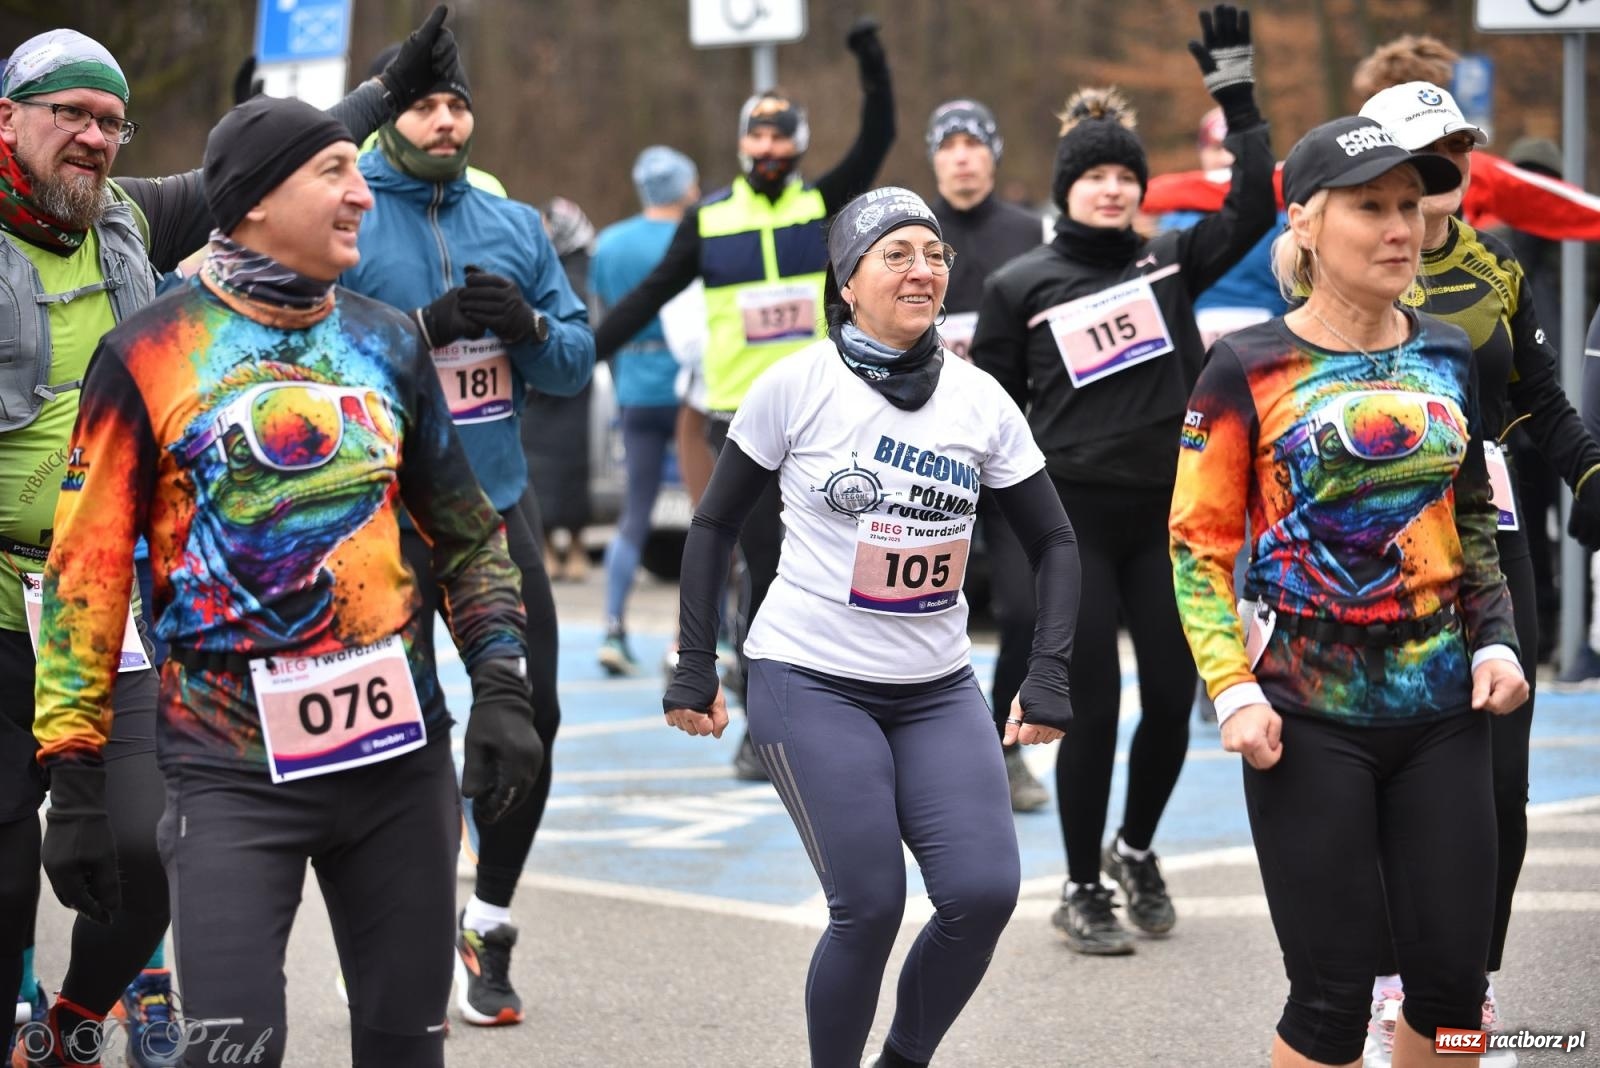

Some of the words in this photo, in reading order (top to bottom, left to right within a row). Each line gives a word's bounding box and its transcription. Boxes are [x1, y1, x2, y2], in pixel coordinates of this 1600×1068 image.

[1087, 314, 1137, 352] 115
[456, 367, 497, 399] 181
[19, 446, 69, 505] RYBNICK
[871, 521, 902, 535] BIEG
[906, 522, 967, 538] Twardziela
[885, 552, 951, 589] 105
[298, 676, 393, 736] 076
